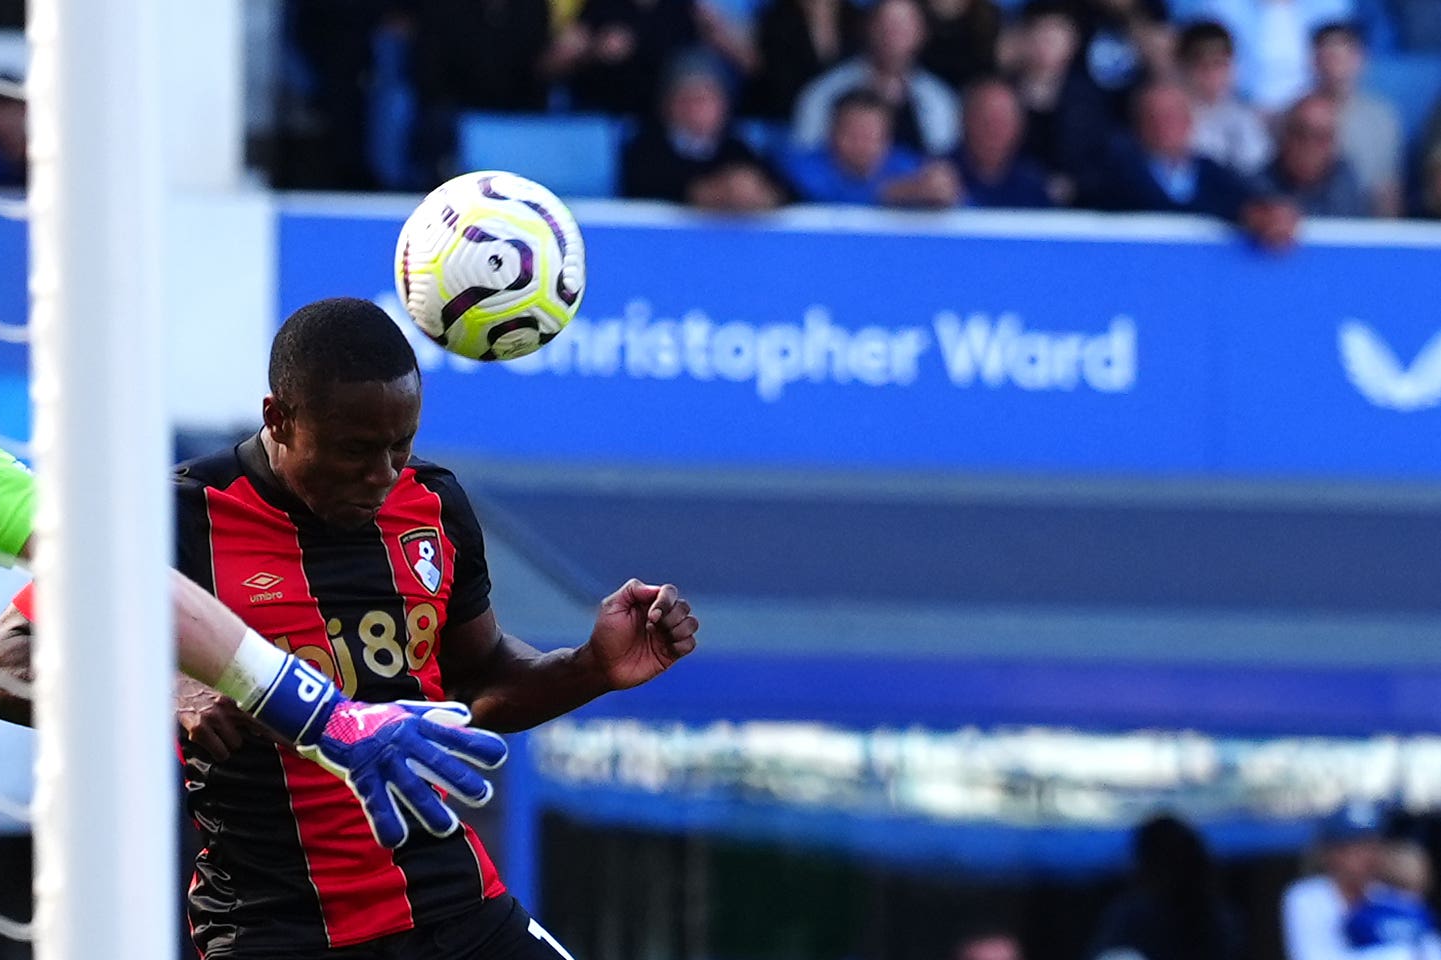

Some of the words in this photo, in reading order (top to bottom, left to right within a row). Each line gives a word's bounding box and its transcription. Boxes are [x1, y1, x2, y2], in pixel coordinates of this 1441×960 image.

[502, 300, 932, 400] hristopher
[932, 309, 1138, 395] Ward
[249, 590, 284, 603] umbro
